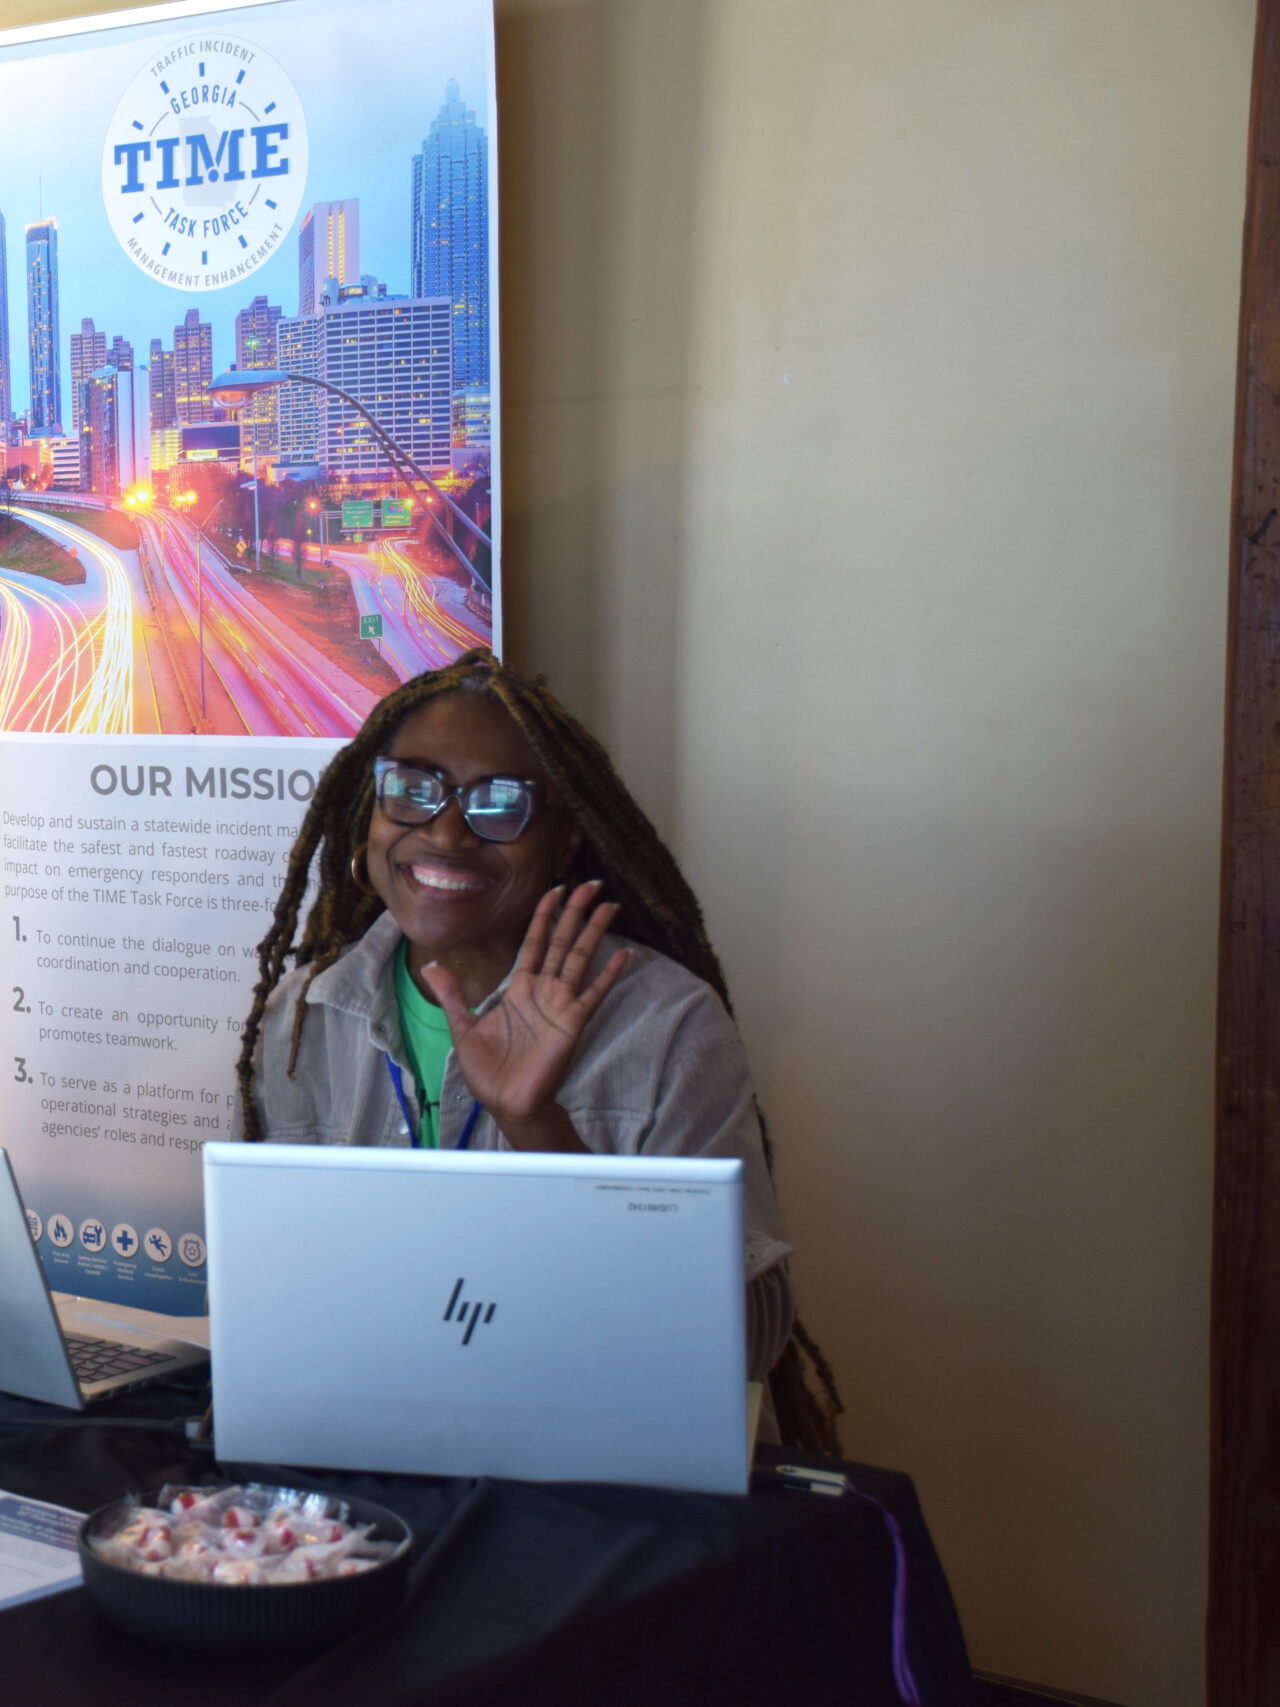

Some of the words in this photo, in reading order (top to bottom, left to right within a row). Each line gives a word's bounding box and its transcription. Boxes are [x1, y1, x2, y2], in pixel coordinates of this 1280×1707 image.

[150, 43, 195, 77] TRAFFIC
[200, 40, 256, 64] INCIDENT
[170, 84, 237, 115] GEORGIA
[114, 122, 290, 194] TIME
[163, 207, 197, 238] TASK
[203, 201, 248, 238] FORCE
[126, 236, 201, 287] MANAGEMENT
[204, 222, 284, 287] ENHANCEMENT
[90, 763, 172, 797] OUR
[185, 766, 322, 802] MISSIO
[3, 810, 45, 831] Develop
[49, 815, 73, 829] and
[77, 817, 126, 831] sustain
[131, 820, 139, 831] a
[144, 819, 211, 834] statewide
[216, 820, 272, 836] incident
[3, 834, 47, 852] facilitate
[53, 838, 74, 853] the
[81, 840, 121, 855] safest
[128, 842, 155, 857] and
[162, 842, 208, 859] fastest
[215, 846, 275, 866] roadway
[4, 858, 39, 876] impact
[45, 865, 61, 876] on
[68, 866, 144, 884] emergency
[151, 870, 230, 886] responders
[237, 872, 264, 887] and
[4, 885, 48, 901] purpose
[51, 887, 65, 900] of
[68, 888, 89, 902] the
[92, 889, 127, 904] TIME
[130, 890, 162, 906] Task
[166, 892, 202, 908] Force
[207, 895, 218, 909] is
[222, 896, 277, 913] three-fo
[12, 915, 28, 942] 1.
[36, 930, 51, 945] To
[57, 933, 116, 949] continue
[122, 936, 145, 950] the
[152, 937, 211, 958] dialogue
[218, 945, 235, 957] on
[37, 955, 120, 973] coordination
[124, 961, 150, 975] and
[154, 964, 240, 982] cooperation.
[12, 986, 31, 1014] 2.
[38, 1000, 53, 1016] To
[61, 1006, 103, 1020] create
[111, 1010, 129, 1022] an
[137, 1012, 219, 1034] opportunity
[227, 1016, 248, 1032] for
[39, 1027, 102, 1045] promotes
[106, 1031, 178, 1051] teamwork.
[14, 1056, 33, 1084] 3.
[40, 1071, 56, 1087] To
[61, 1077, 97, 1091] serve
[103, 1080, 118, 1093] as
[123, 1083, 131, 1094] a
[137, 1082, 195, 1101] platform
[200, 1088, 220, 1104] for
[41, 1098, 116, 1117] operational
[122, 1106, 187, 1127] strategies
[193, 1115, 220, 1129] and
[104, 1128, 137, 1143] roles
[140, 1132, 165, 1147] and
[169, 1136, 206, 1155] respo
